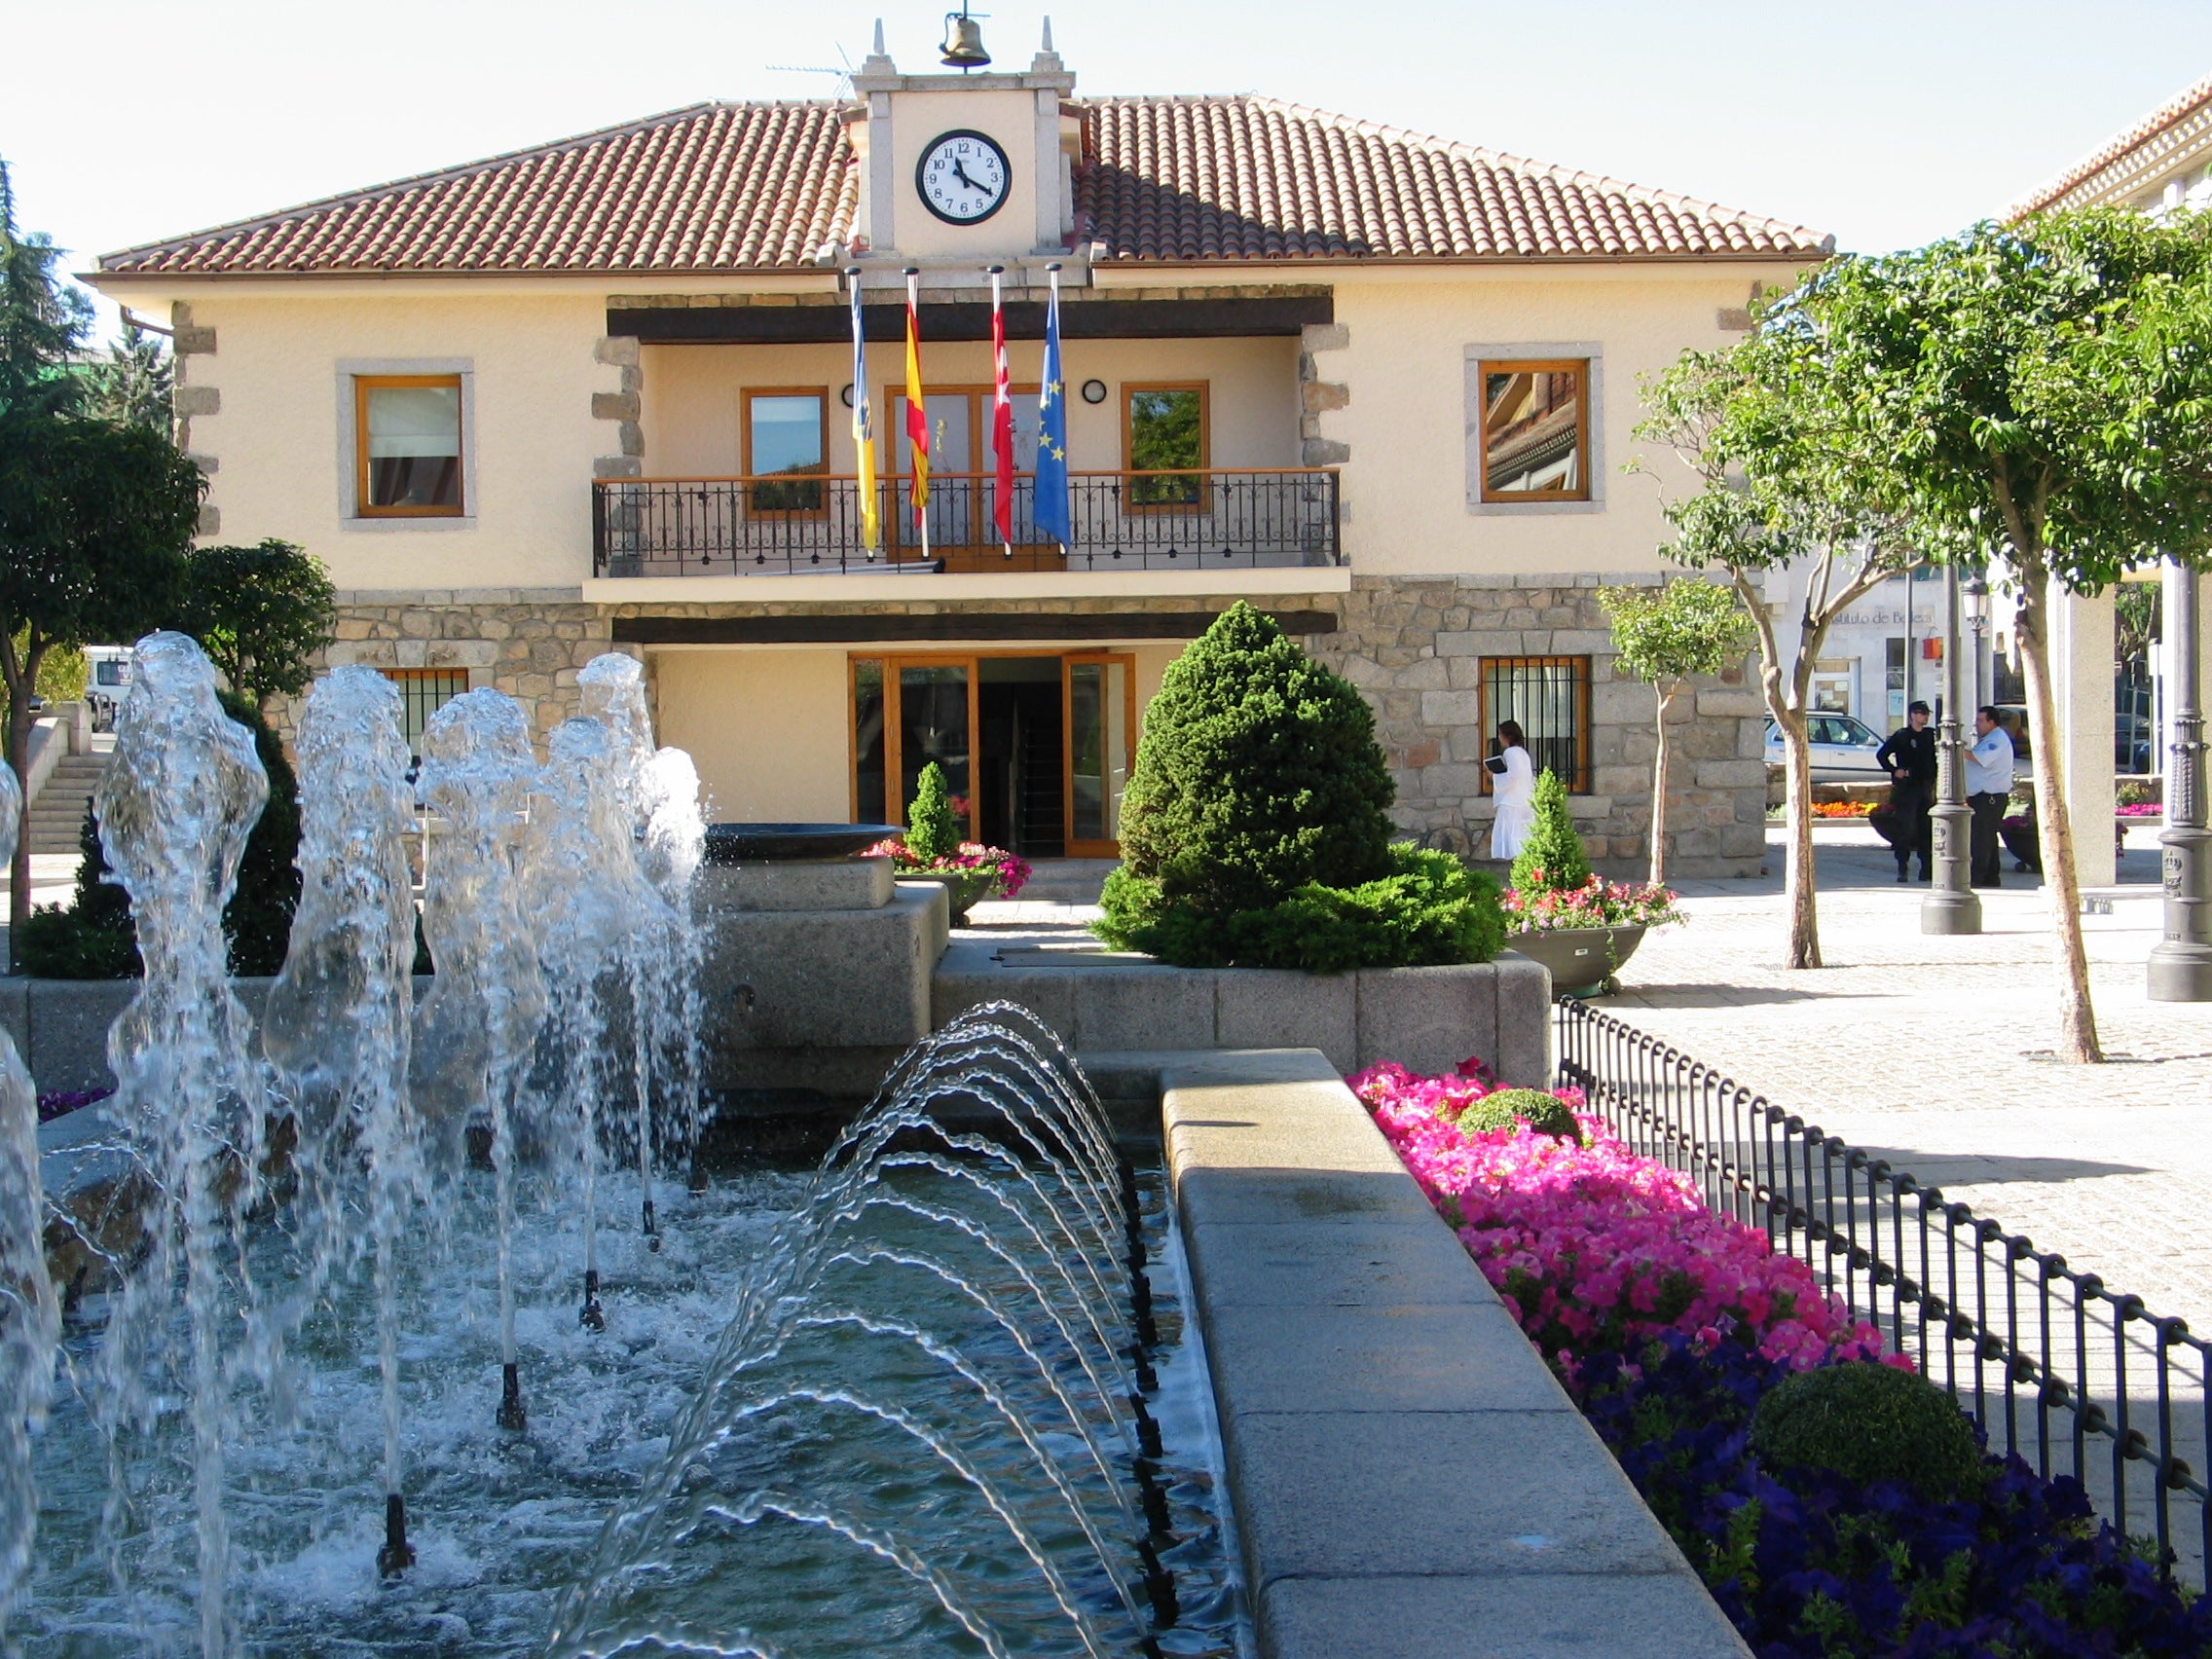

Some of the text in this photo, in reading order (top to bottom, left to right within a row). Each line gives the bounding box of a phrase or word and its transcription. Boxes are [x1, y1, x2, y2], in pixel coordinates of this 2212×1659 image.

[944, 148, 953, 158] 11
[958, 143, 970, 153] 12
[977, 147, 981, 157] 1
[934, 160, 945, 169] 10
[986, 158, 994, 167] 2
[929, 174, 937, 184] 9
[990, 172, 999, 182] 3
[934, 188, 942, 199] 8
[946, 199, 953, 208] 7
[960, 203, 968, 212] 6
[976, 199, 983, 208] 5
[1831, 612, 1869, 624] stituto
[1872, 611, 1890, 624] de
